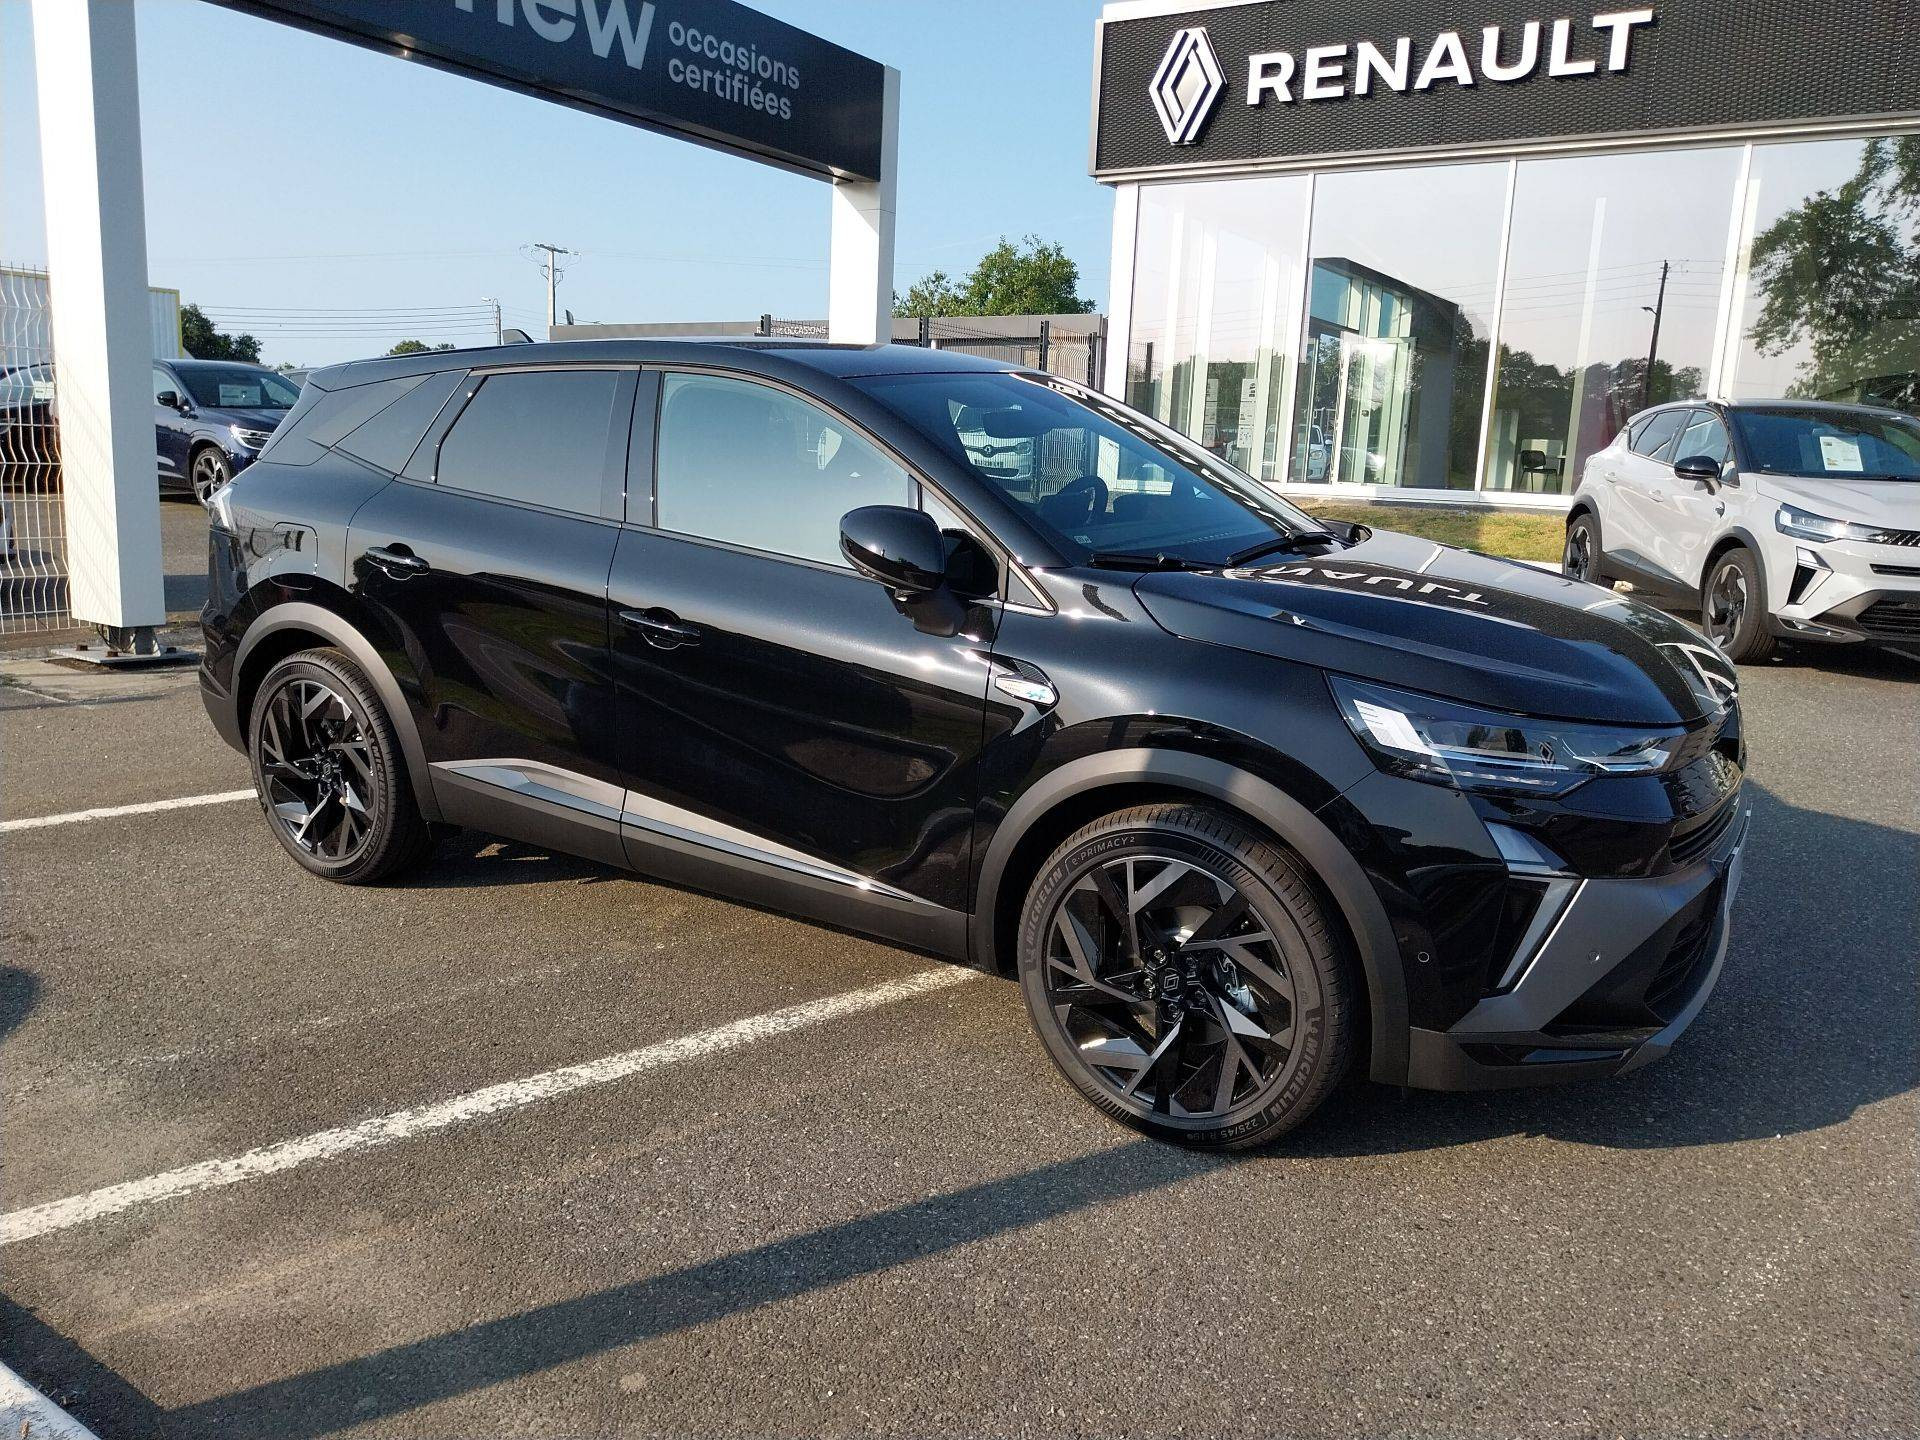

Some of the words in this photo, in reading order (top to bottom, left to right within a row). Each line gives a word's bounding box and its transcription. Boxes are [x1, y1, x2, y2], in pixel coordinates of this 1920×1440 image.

[455, 0, 656, 70] ew
[669, 21, 800, 90] occasions
[1246, 8, 1653, 106] RENAULT
[669, 58, 792, 120] certifiées
[1026, 867, 1063, 946] MICHELIN
[1270, 1039, 1319, 1118] MICHELIN
[1220, 1118, 1258, 1139] 225/45
